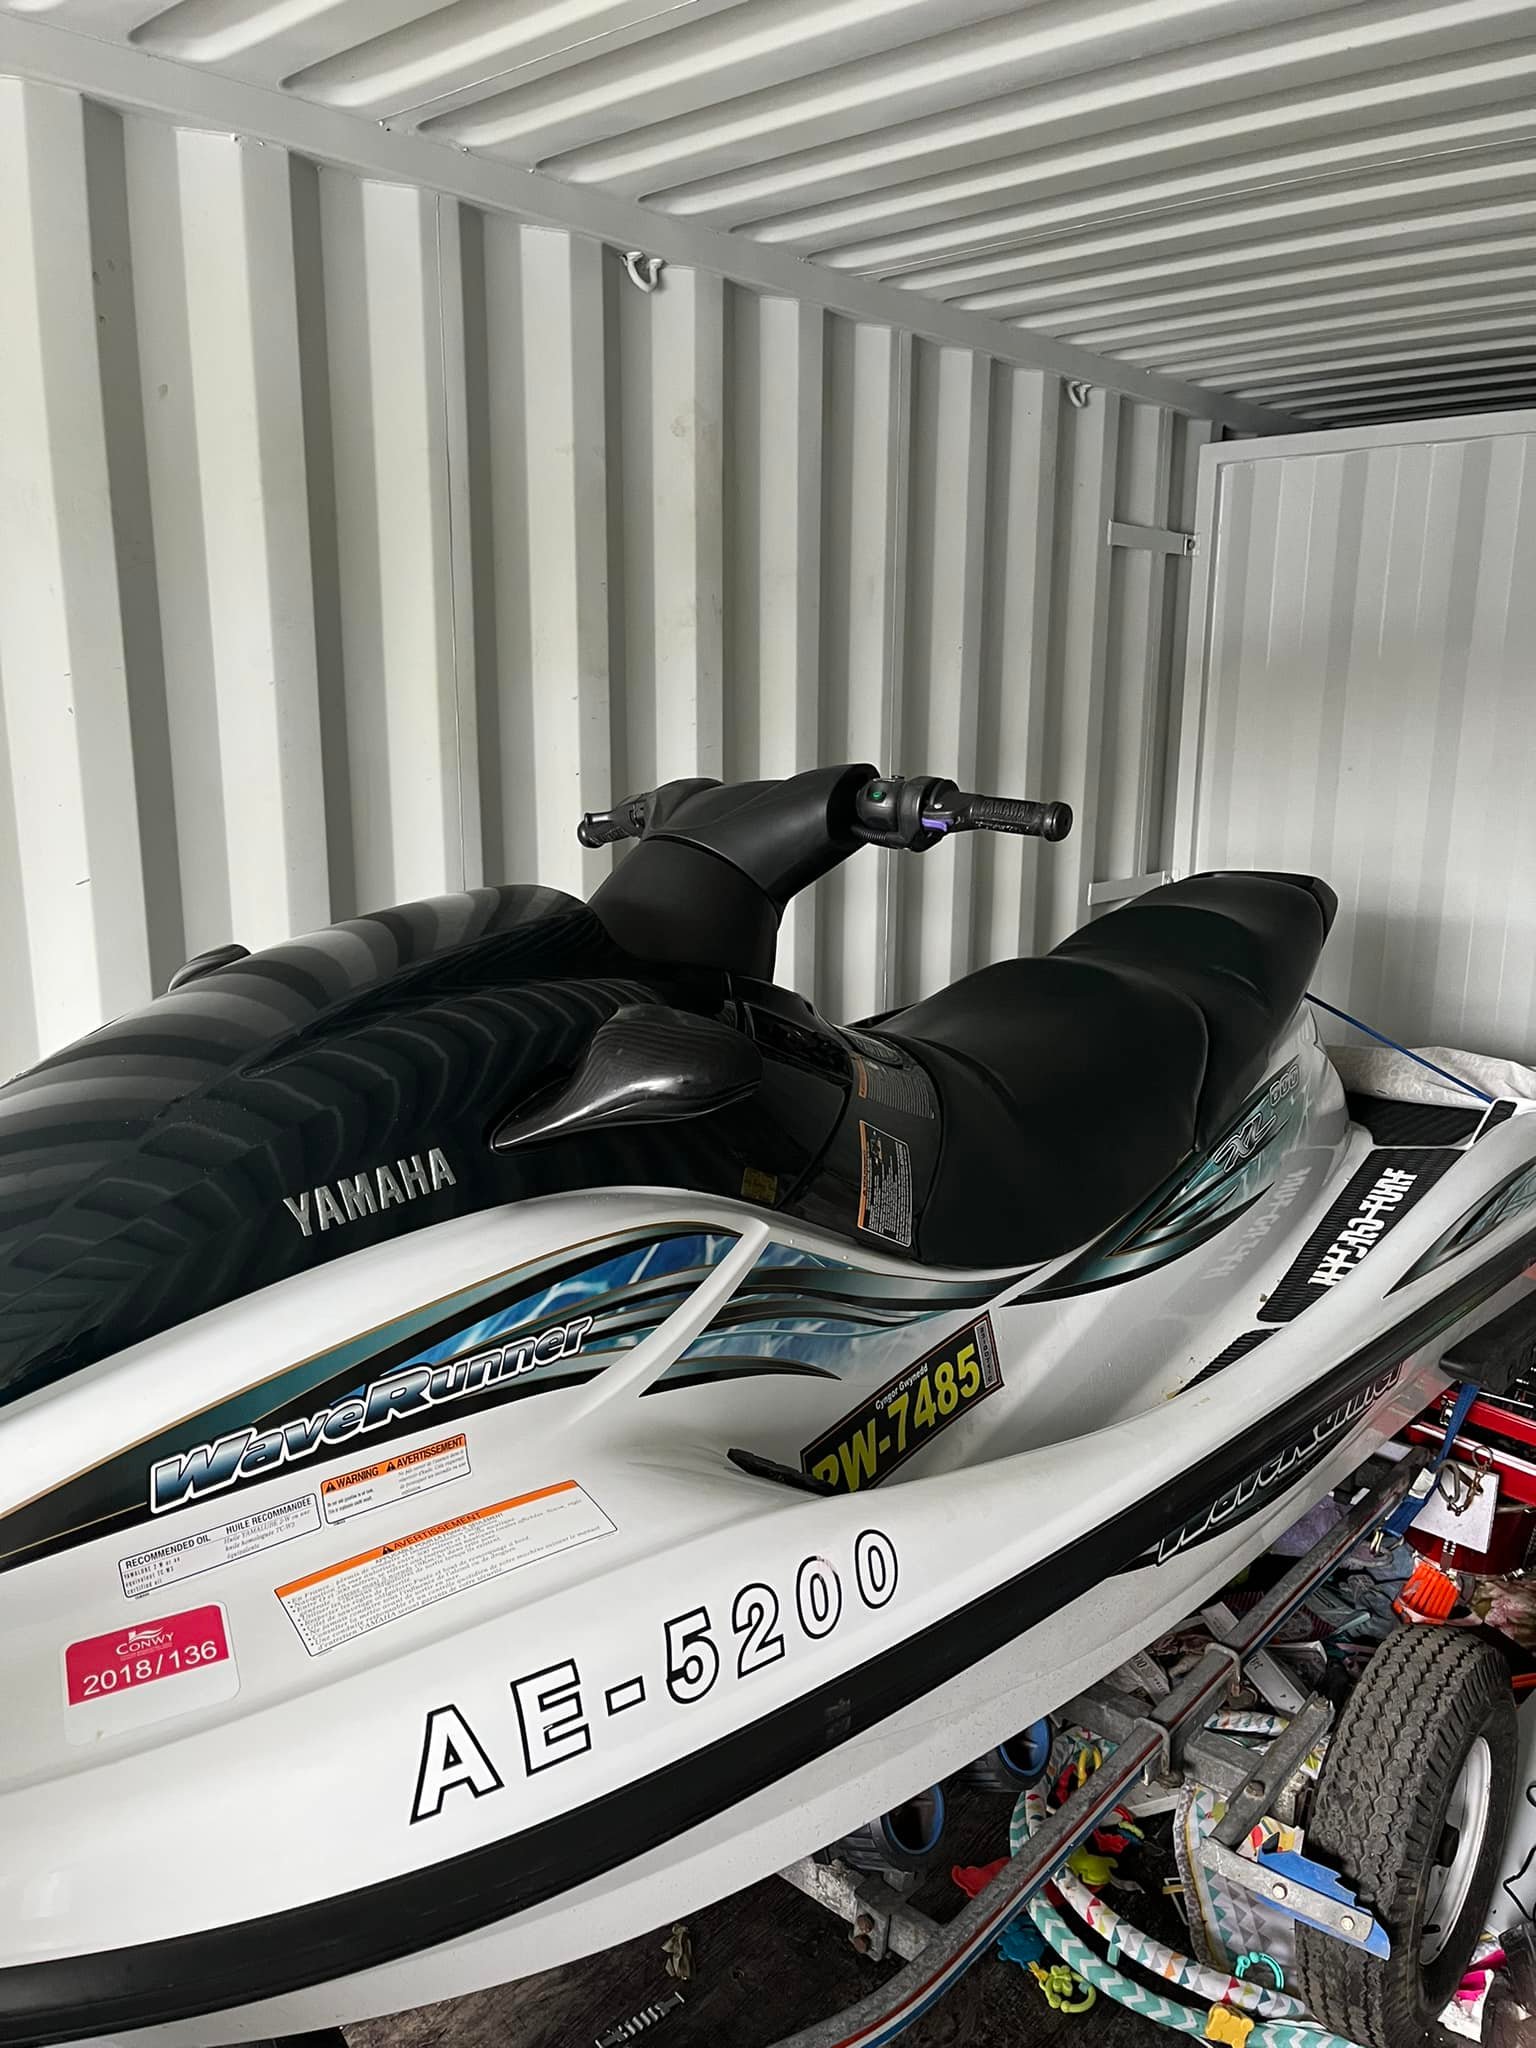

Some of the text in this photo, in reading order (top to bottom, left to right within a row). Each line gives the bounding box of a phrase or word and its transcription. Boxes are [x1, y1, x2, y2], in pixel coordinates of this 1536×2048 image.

[1214, 1112, 1278, 1173] XL
[282, 1147, 457, 1237] YAMAHA
[875, 1363, 928, 1410] Cyngor Gwynedd
[151, 1317, 595, 1513] WaveRunner
[396, 1437, 463, 1468] AVERTISSEMENT
[336, 1467, 379, 1488] WARNING
[226, 1520, 250, 1535] HUILE
[394, 1512, 482, 1549] AVERTISSEMENT
[125, 1534, 211, 1569] RECOMMENDED OIL
[116, 1632, 174, 1655] CONWY
[83, 1640, 217, 1696] 2018/136
[410, 1528, 898, 1826] AE-5200
